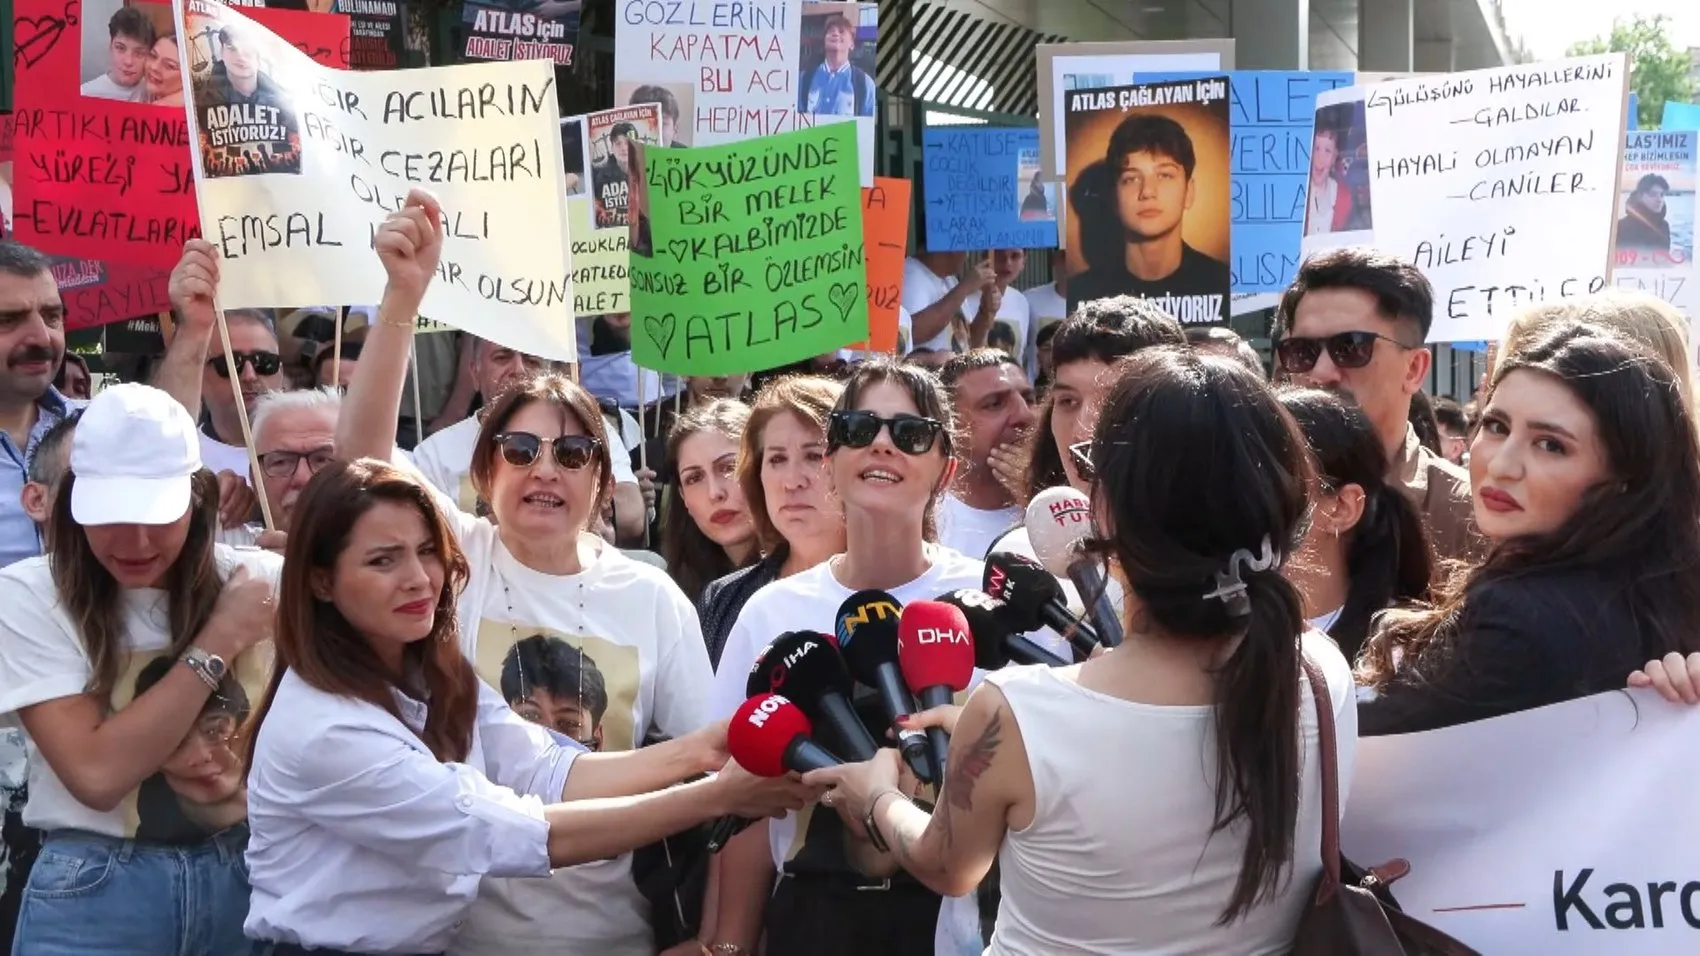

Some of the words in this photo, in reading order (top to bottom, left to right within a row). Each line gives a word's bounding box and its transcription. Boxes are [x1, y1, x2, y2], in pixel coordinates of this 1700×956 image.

[473, 9, 536, 36] ATLAS
[537, 19, 565, 42] için
[465, 36, 512, 60] ADALET
[512, 37, 574, 65] İSTİYORUZ
[650, 32, 784, 62] KAPATMA
[700, 66, 733, 93] BU
[747, 69, 789, 93] ACI
[1489, 62, 1612, 94] HAYALLERİNİ
[383, 78, 553, 124] ACILARIN
[1071, 91, 1116, 112] ATLAS
[1119, 84, 1193, 112] ÇAĞLAYAN
[1196, 80, 1225, 105] İÇİN
[207, 103, 280, 129] ADALET
[591, 115, 609, 127] ATLAS
[212, 125, 287, 147] İSTİYORUZ!
[381, 139, 542, 183] CEZALARI
[648, 136, 840, 198] GÖKYÜZÜNDE
[1376, 151, 1457, 179] HAYALİ
[1475, 129, 1594, 168] OLMAYAN
[678, 193, 730, 226] BİR
[746, 175, 836, 216] MELEK
[478, 272, 571, 307] OLSUN
[630, 266, 689, 296] SONSUZ
[703, 262, 752, 295] BİR
[685, 294, 823, 360] ATLAS
[917, 627, 970, 646] DHA
